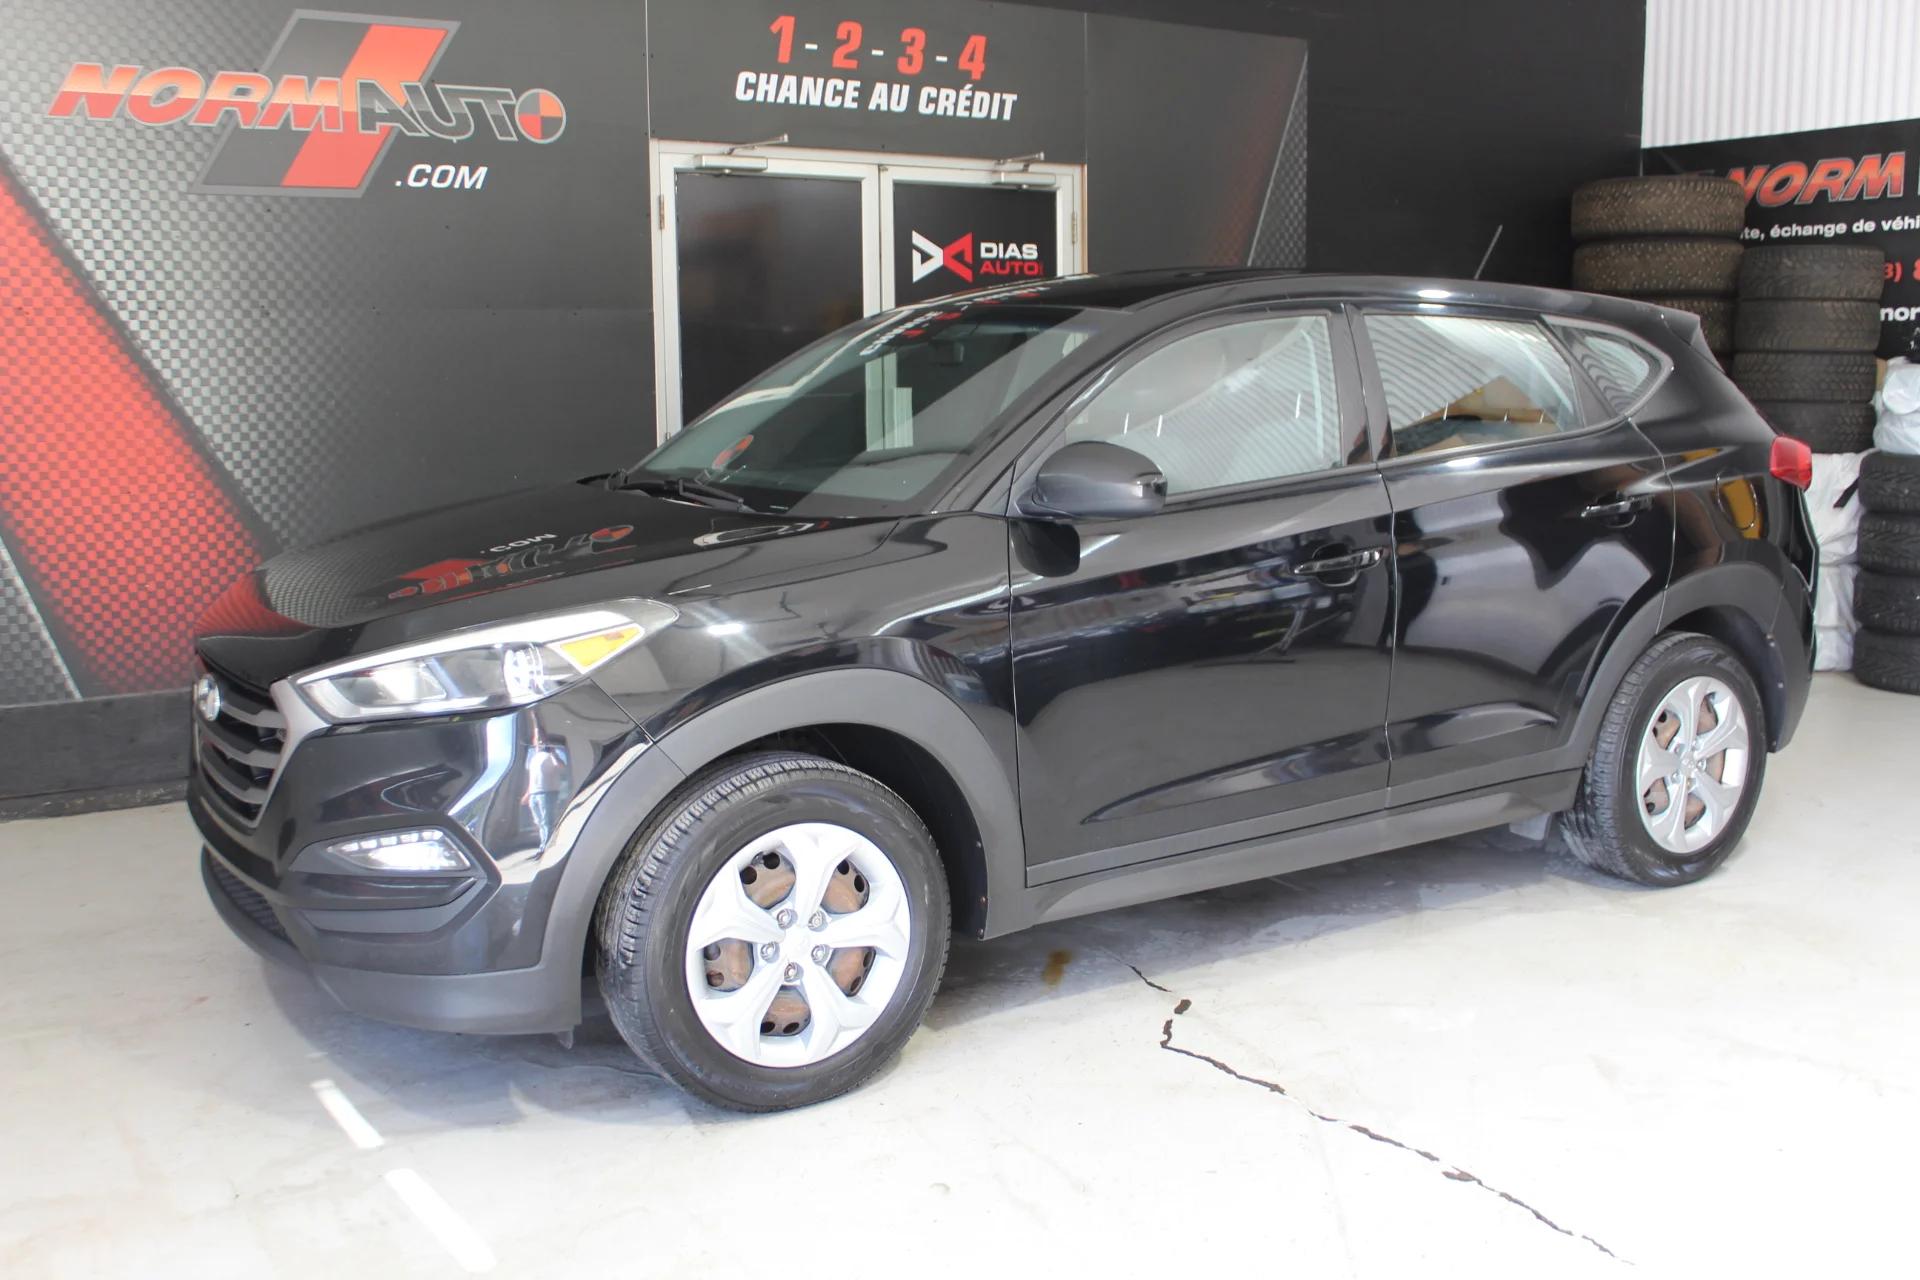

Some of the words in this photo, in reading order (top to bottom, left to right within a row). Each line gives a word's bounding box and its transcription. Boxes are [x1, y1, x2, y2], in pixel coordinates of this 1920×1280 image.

[735, 71, 861, 109] CHANCE
[868, 82, 910, 113] AU
[918, 84, 1018, 121] CRÉDIT
[395, 164, 487, 190] .COM
[1770, 221, 1847, 238] échange
[1852, 218, 1876, 233] de
[980, 241, 1039, 260] DIAS
[979, 260, 1039, 276] AUTO
